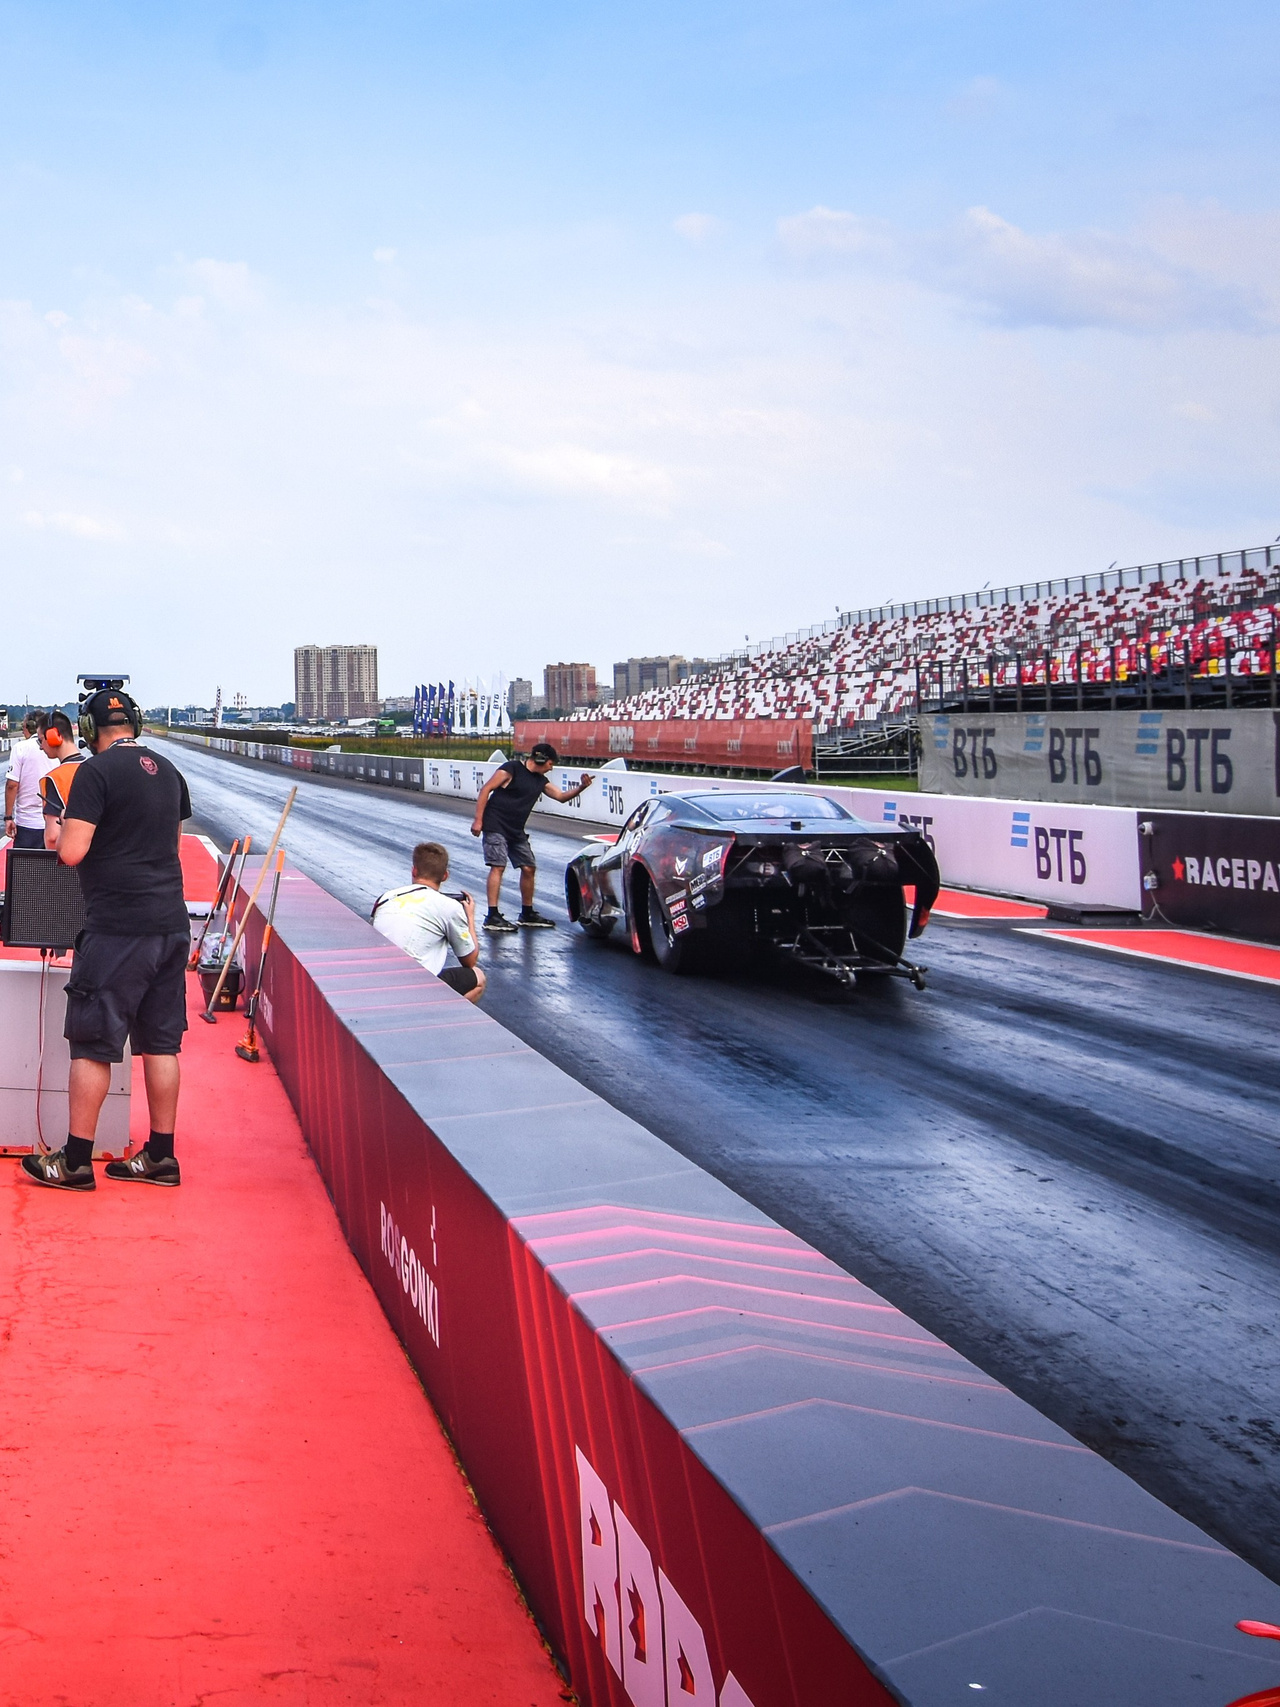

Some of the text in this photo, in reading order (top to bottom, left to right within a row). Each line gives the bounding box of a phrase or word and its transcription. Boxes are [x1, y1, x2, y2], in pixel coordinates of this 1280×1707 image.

[609, 726, 634, 753] RDRC
[953, 727, 997, 780] ВТБ
[1048, 727, 1102, 786] ВТБ
[1166, 727, 1233, 794] ВТБ
[609, 784, 624, 815] ВТБ
[1034, 826, 1087, 885] ВТБ
[1184, 856, 1280, 893] RACEPA
[673, 915, 687, 928] MSD
[46, 1164, 59, 1179] N
[130, 1159, 145, 1174] N
[380, 1200, 440, 1349] ROSGONKI
[575, 1440, 755, 1707] RDR
